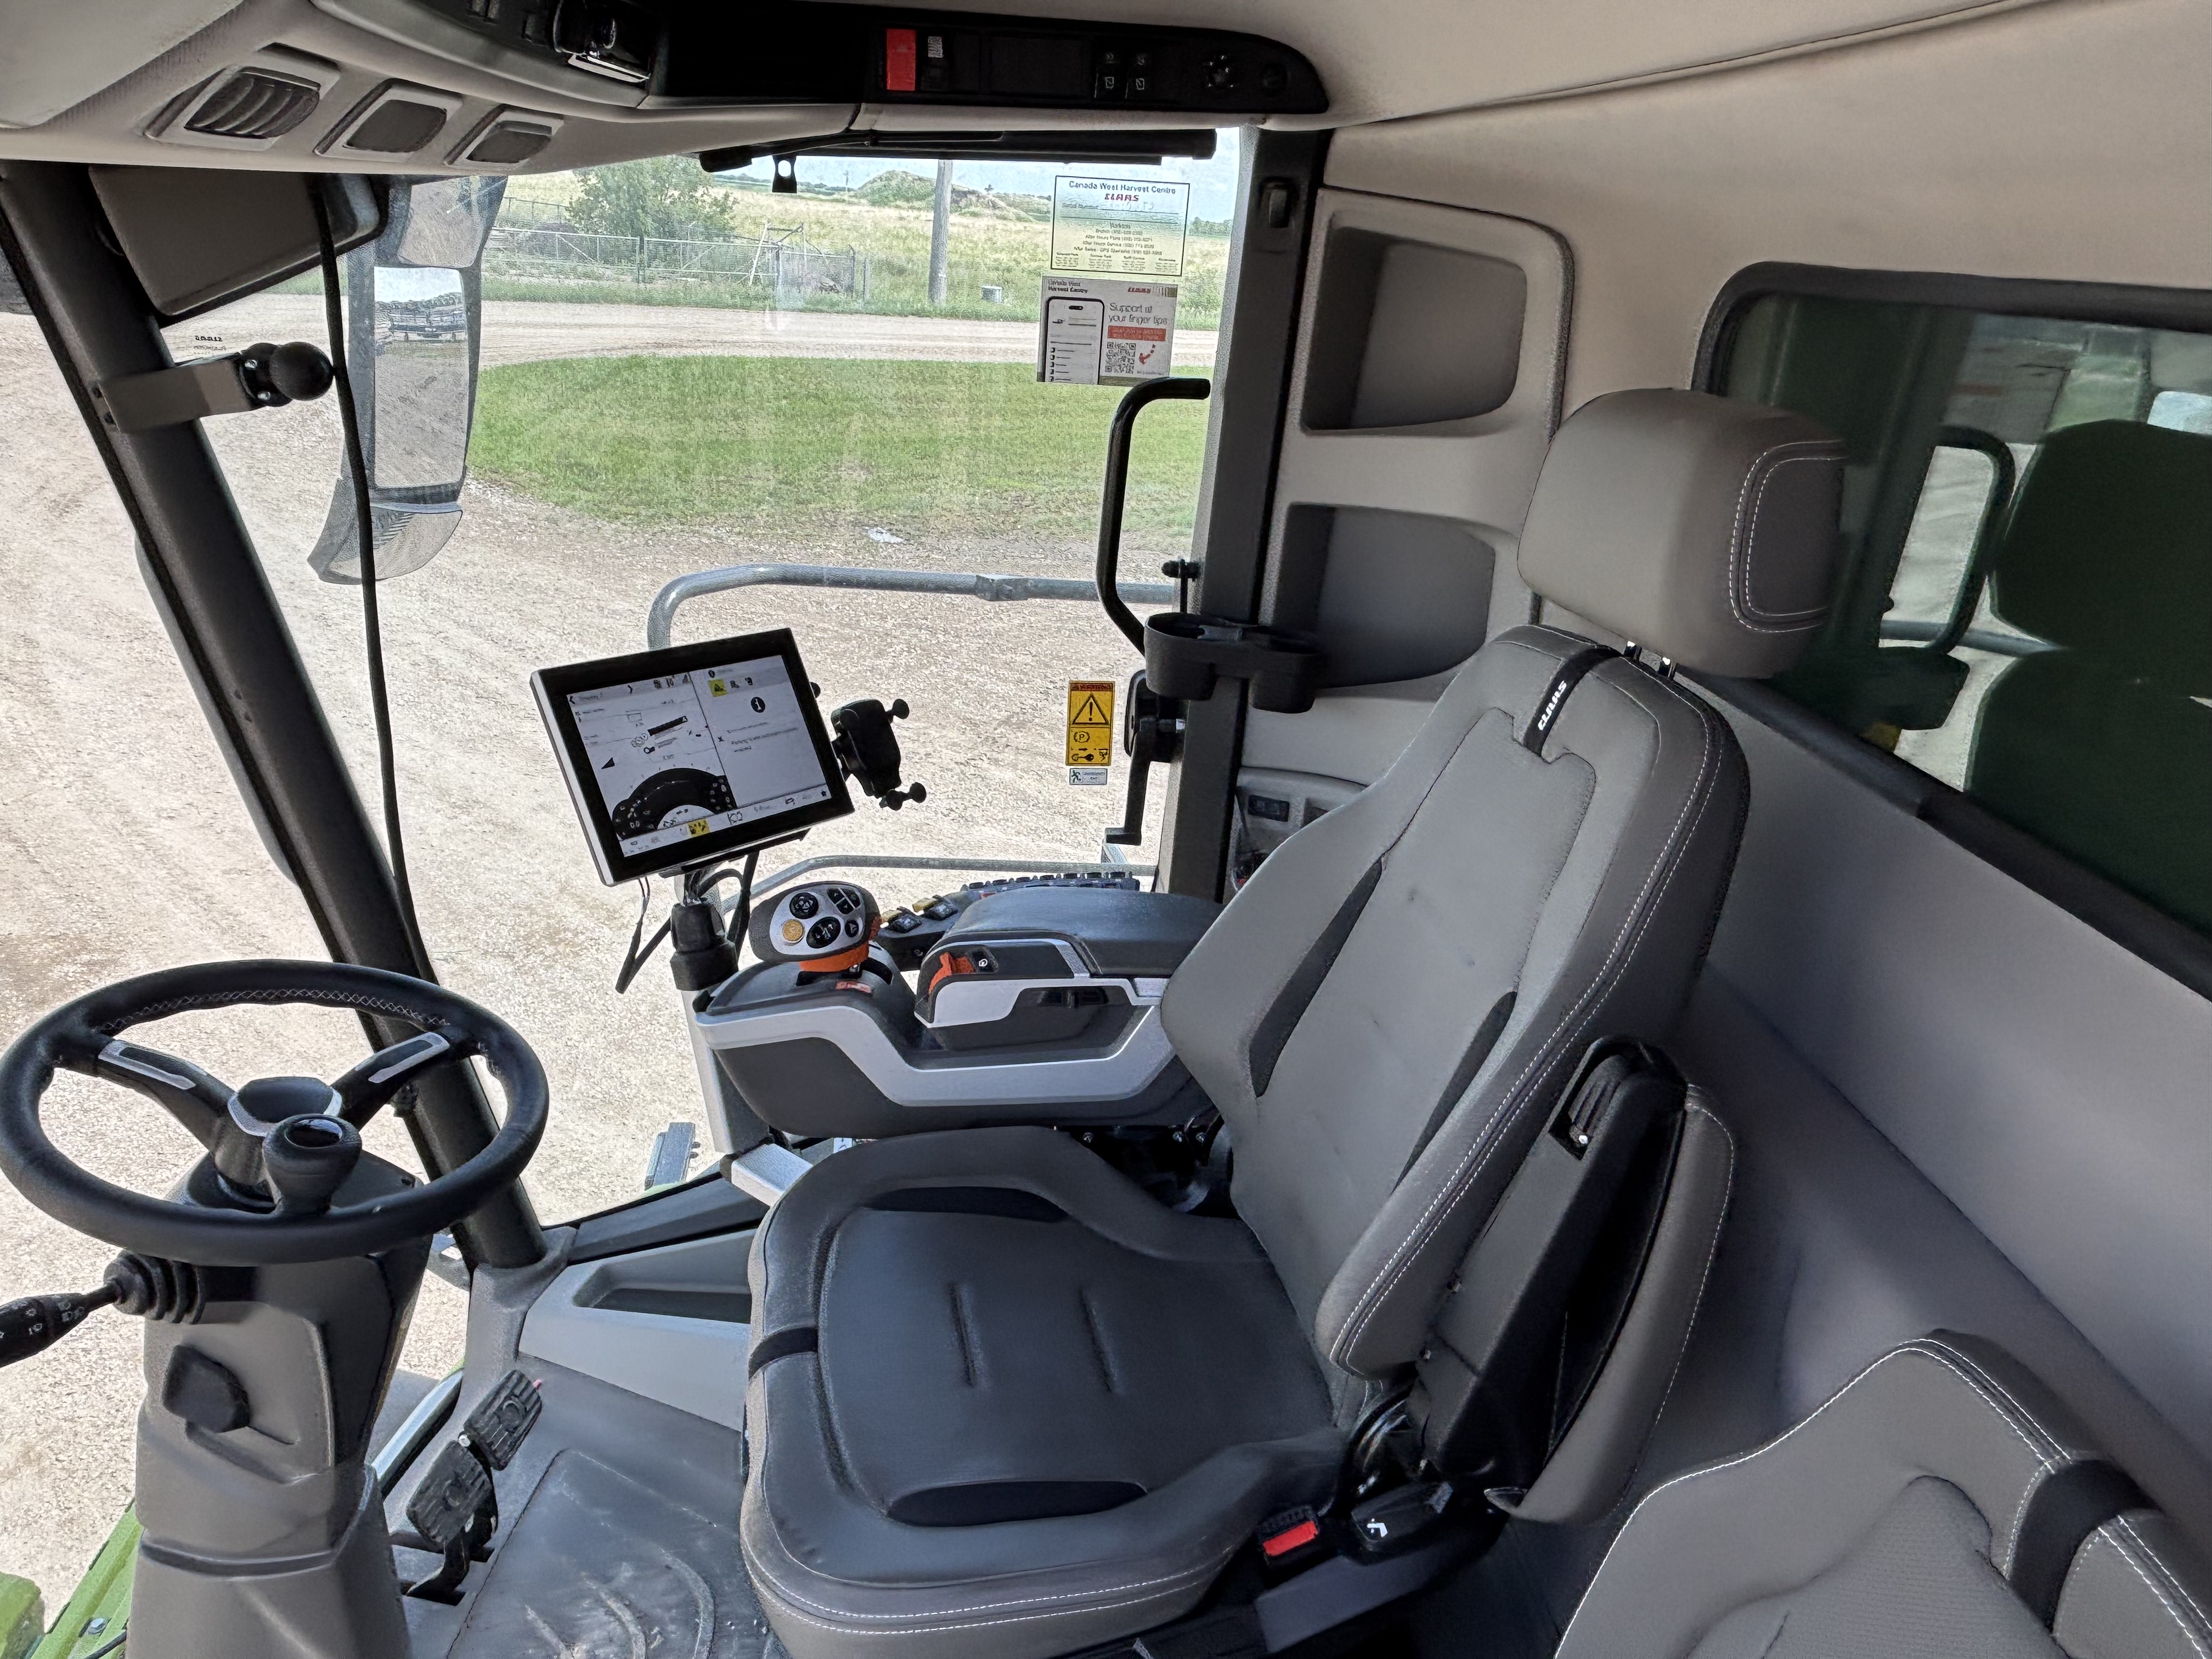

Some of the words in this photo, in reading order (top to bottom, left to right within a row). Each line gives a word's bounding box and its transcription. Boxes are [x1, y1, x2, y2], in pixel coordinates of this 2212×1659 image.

[1069, 180, 1098, 189] Canada
[1099, 182, 1118, 190] West
[1120, 184, 1149, 193] Harvest
[1104, 193, 1139, 201] CLAAS
[1538, 680, 1567, 730] CLAAS
